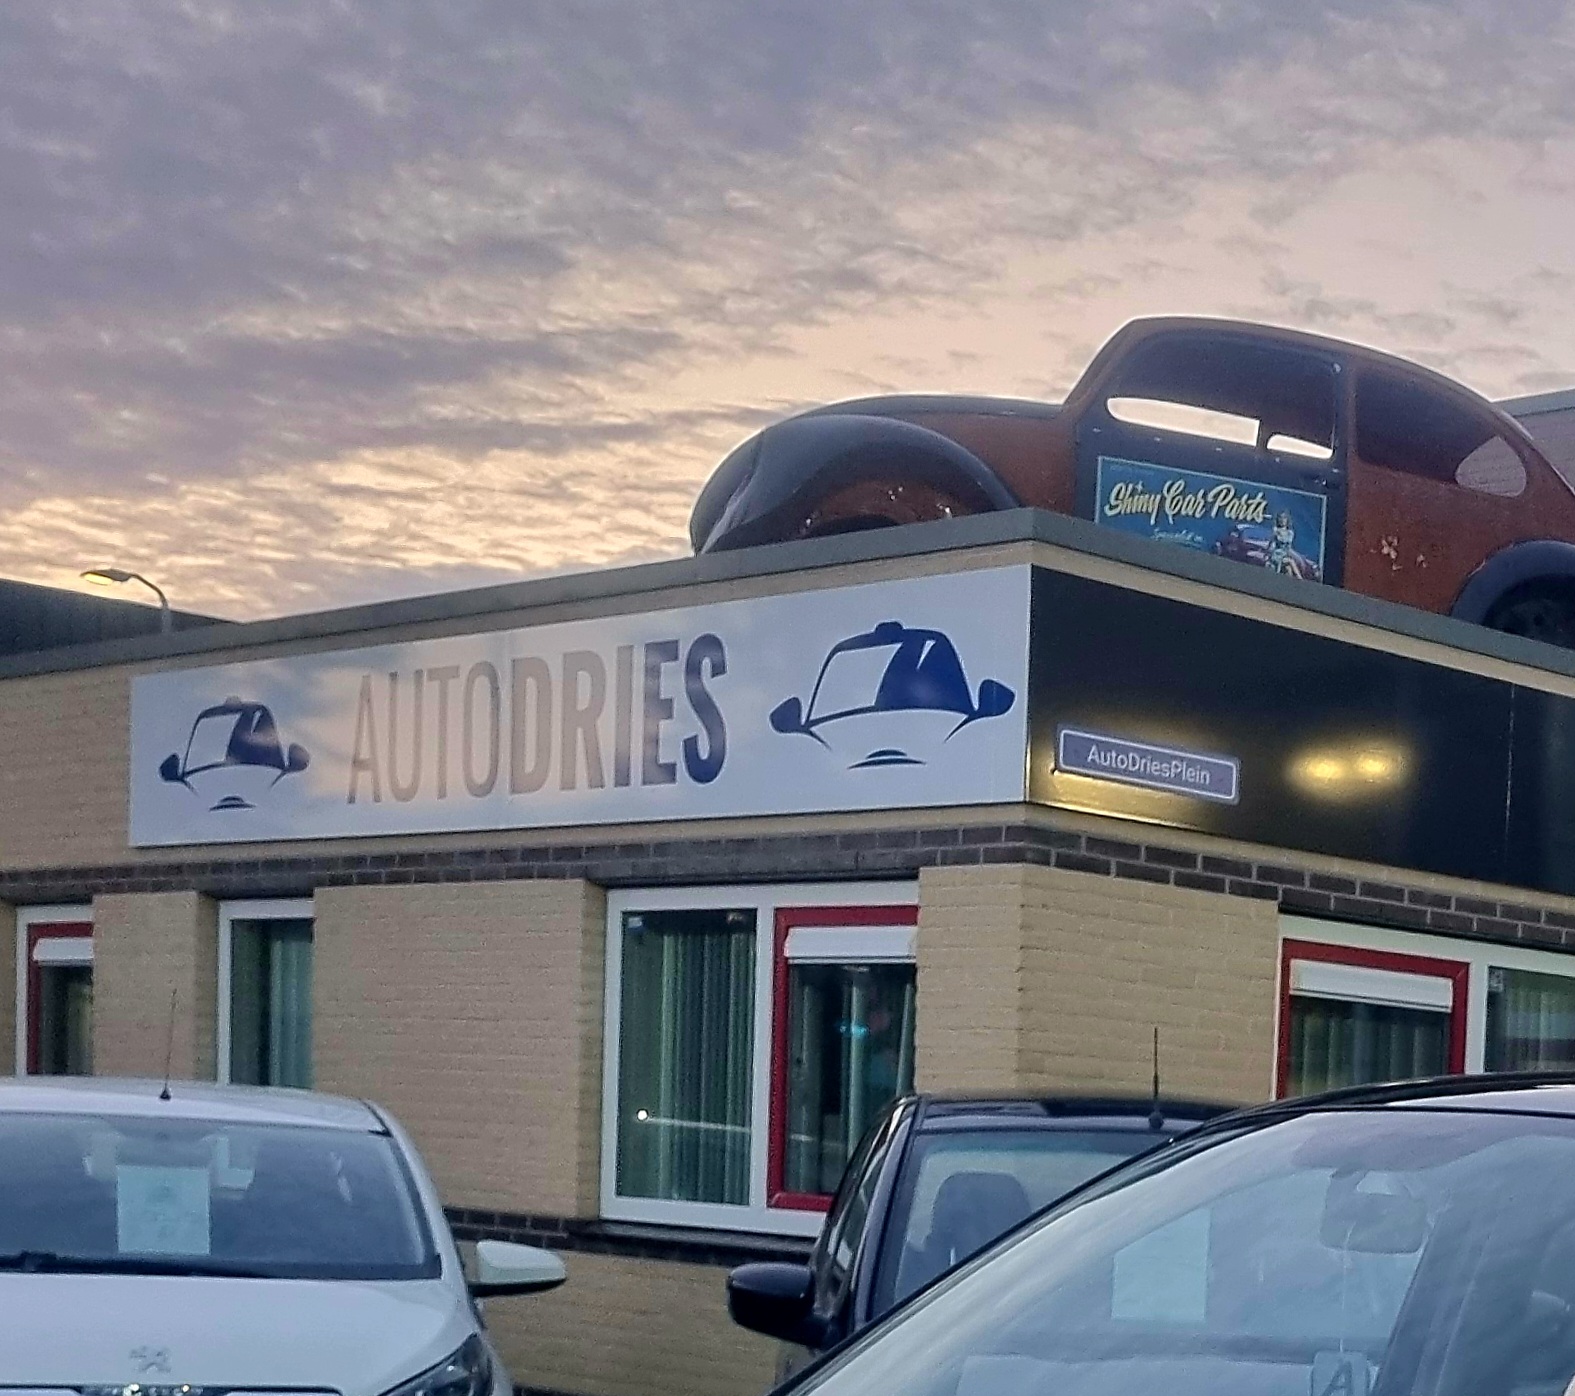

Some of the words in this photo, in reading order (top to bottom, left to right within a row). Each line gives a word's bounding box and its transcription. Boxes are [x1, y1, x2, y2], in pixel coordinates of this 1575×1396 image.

[1104, 482, 1160, 526] Shiny
[1163, 479, 1206, 525] Car
[1208, 484, 1271, 523] Parts
[348, 632, 728, 805] AUTODRIES
[1087, 744, 1211, 786] AutoDriesPlein
